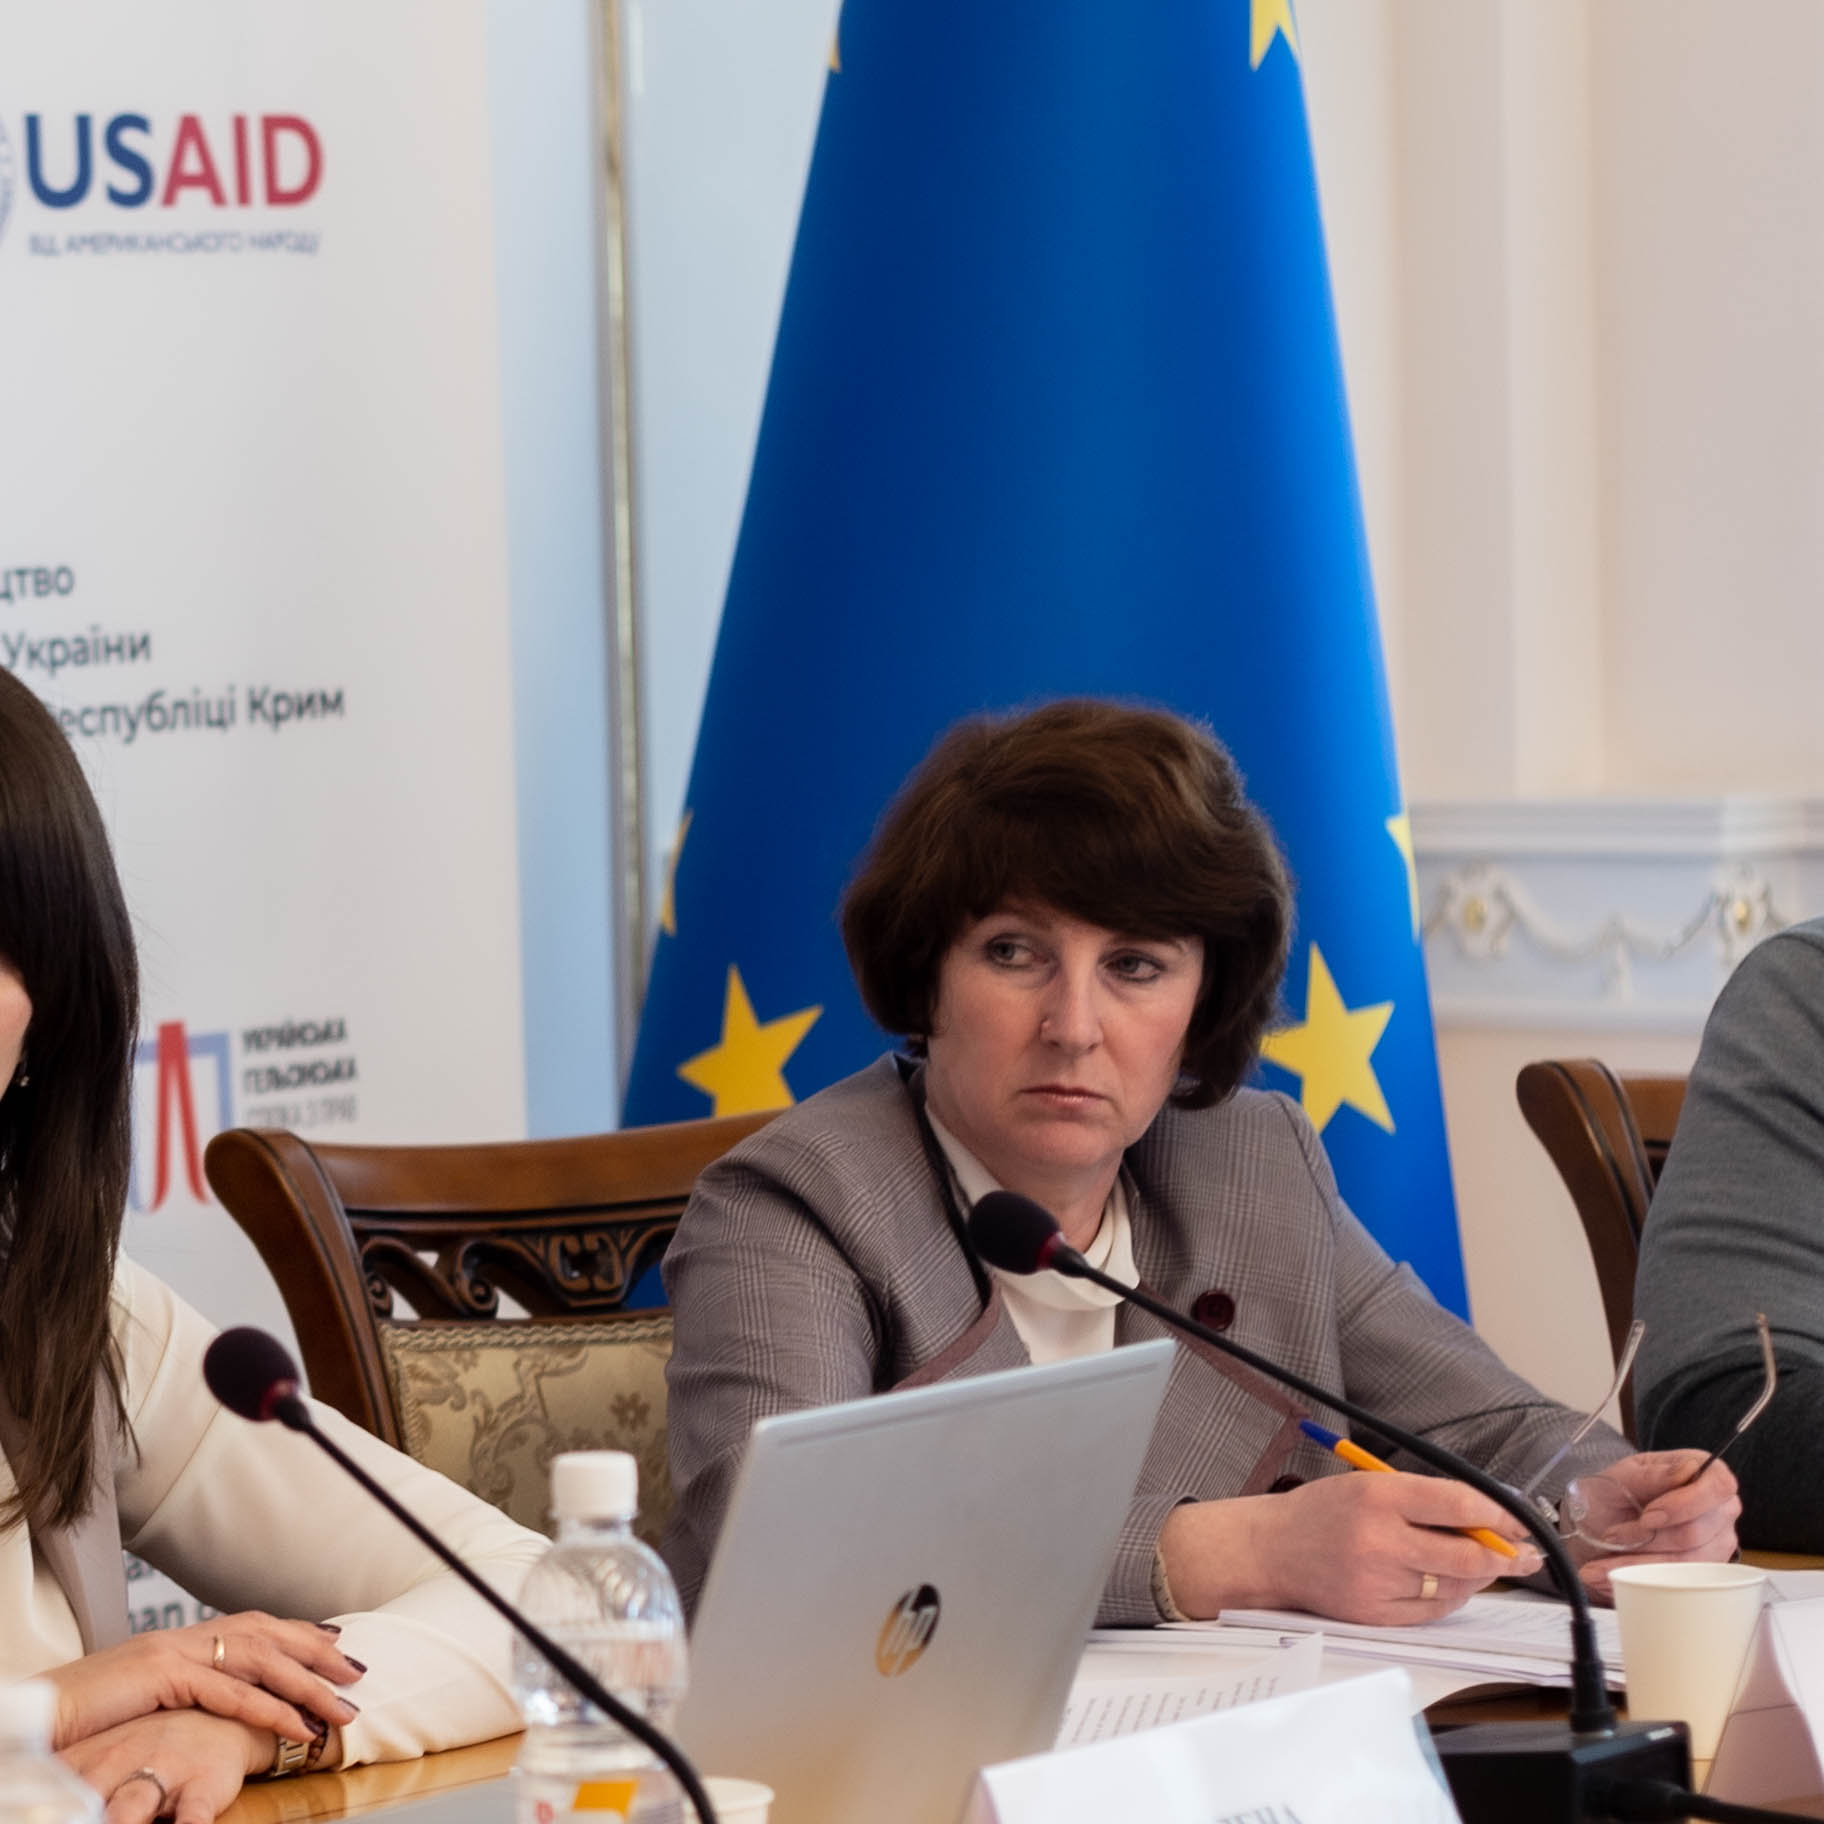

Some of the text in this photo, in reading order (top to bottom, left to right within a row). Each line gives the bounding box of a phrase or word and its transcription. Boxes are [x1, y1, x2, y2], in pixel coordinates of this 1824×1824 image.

[25, 113, 324, 209] USAID
[1, 625, 153, 676] України
[48, 681, 346, 744] еспубліці Крим
